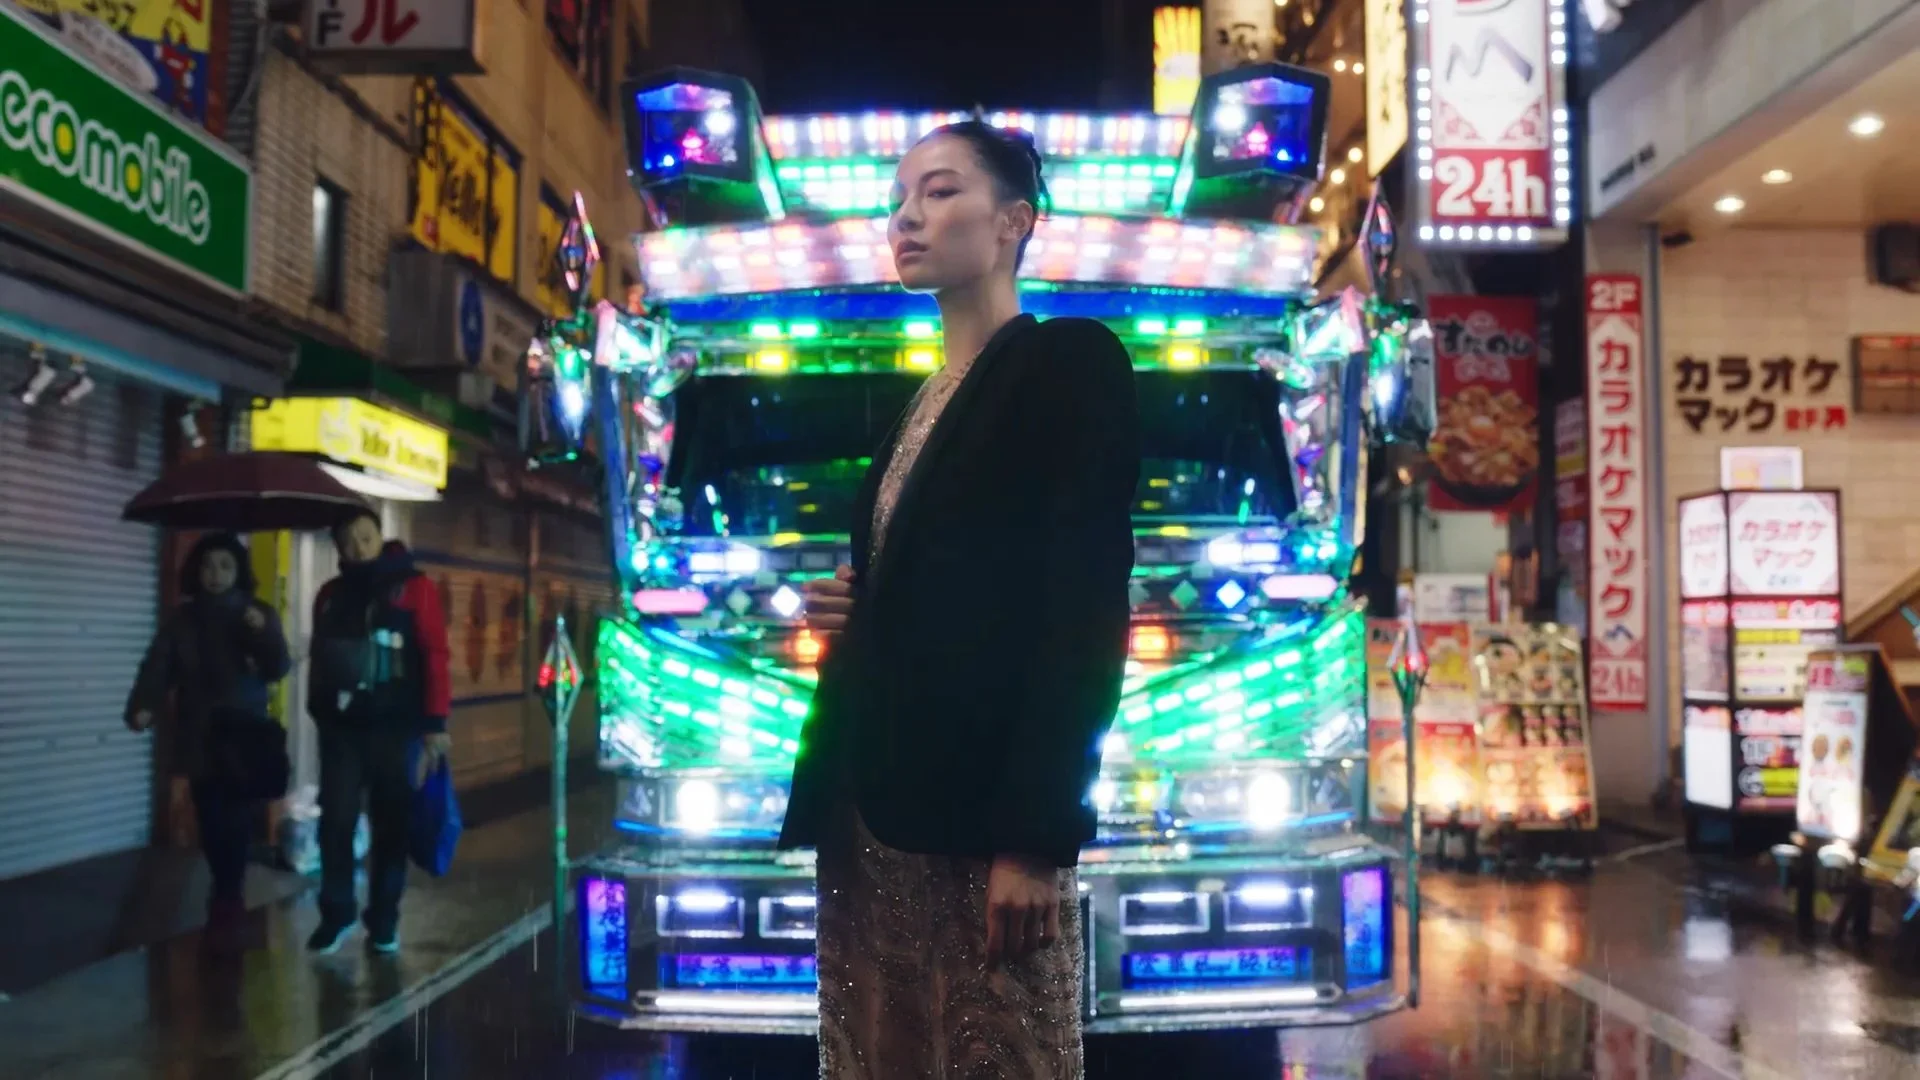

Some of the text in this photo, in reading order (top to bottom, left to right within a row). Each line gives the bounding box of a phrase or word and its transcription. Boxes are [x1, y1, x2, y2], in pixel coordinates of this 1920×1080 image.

[0, 70, 211, 246] ecomobile
[1435, 156, 1546, 217] 24h
[1590, 278, 1638, 310] 2F
[1675, 355, 1839, 393] カラオケ
[1676, 398, 1776, 433] マック
[1738, 520, 1826, 542] カラオケ
